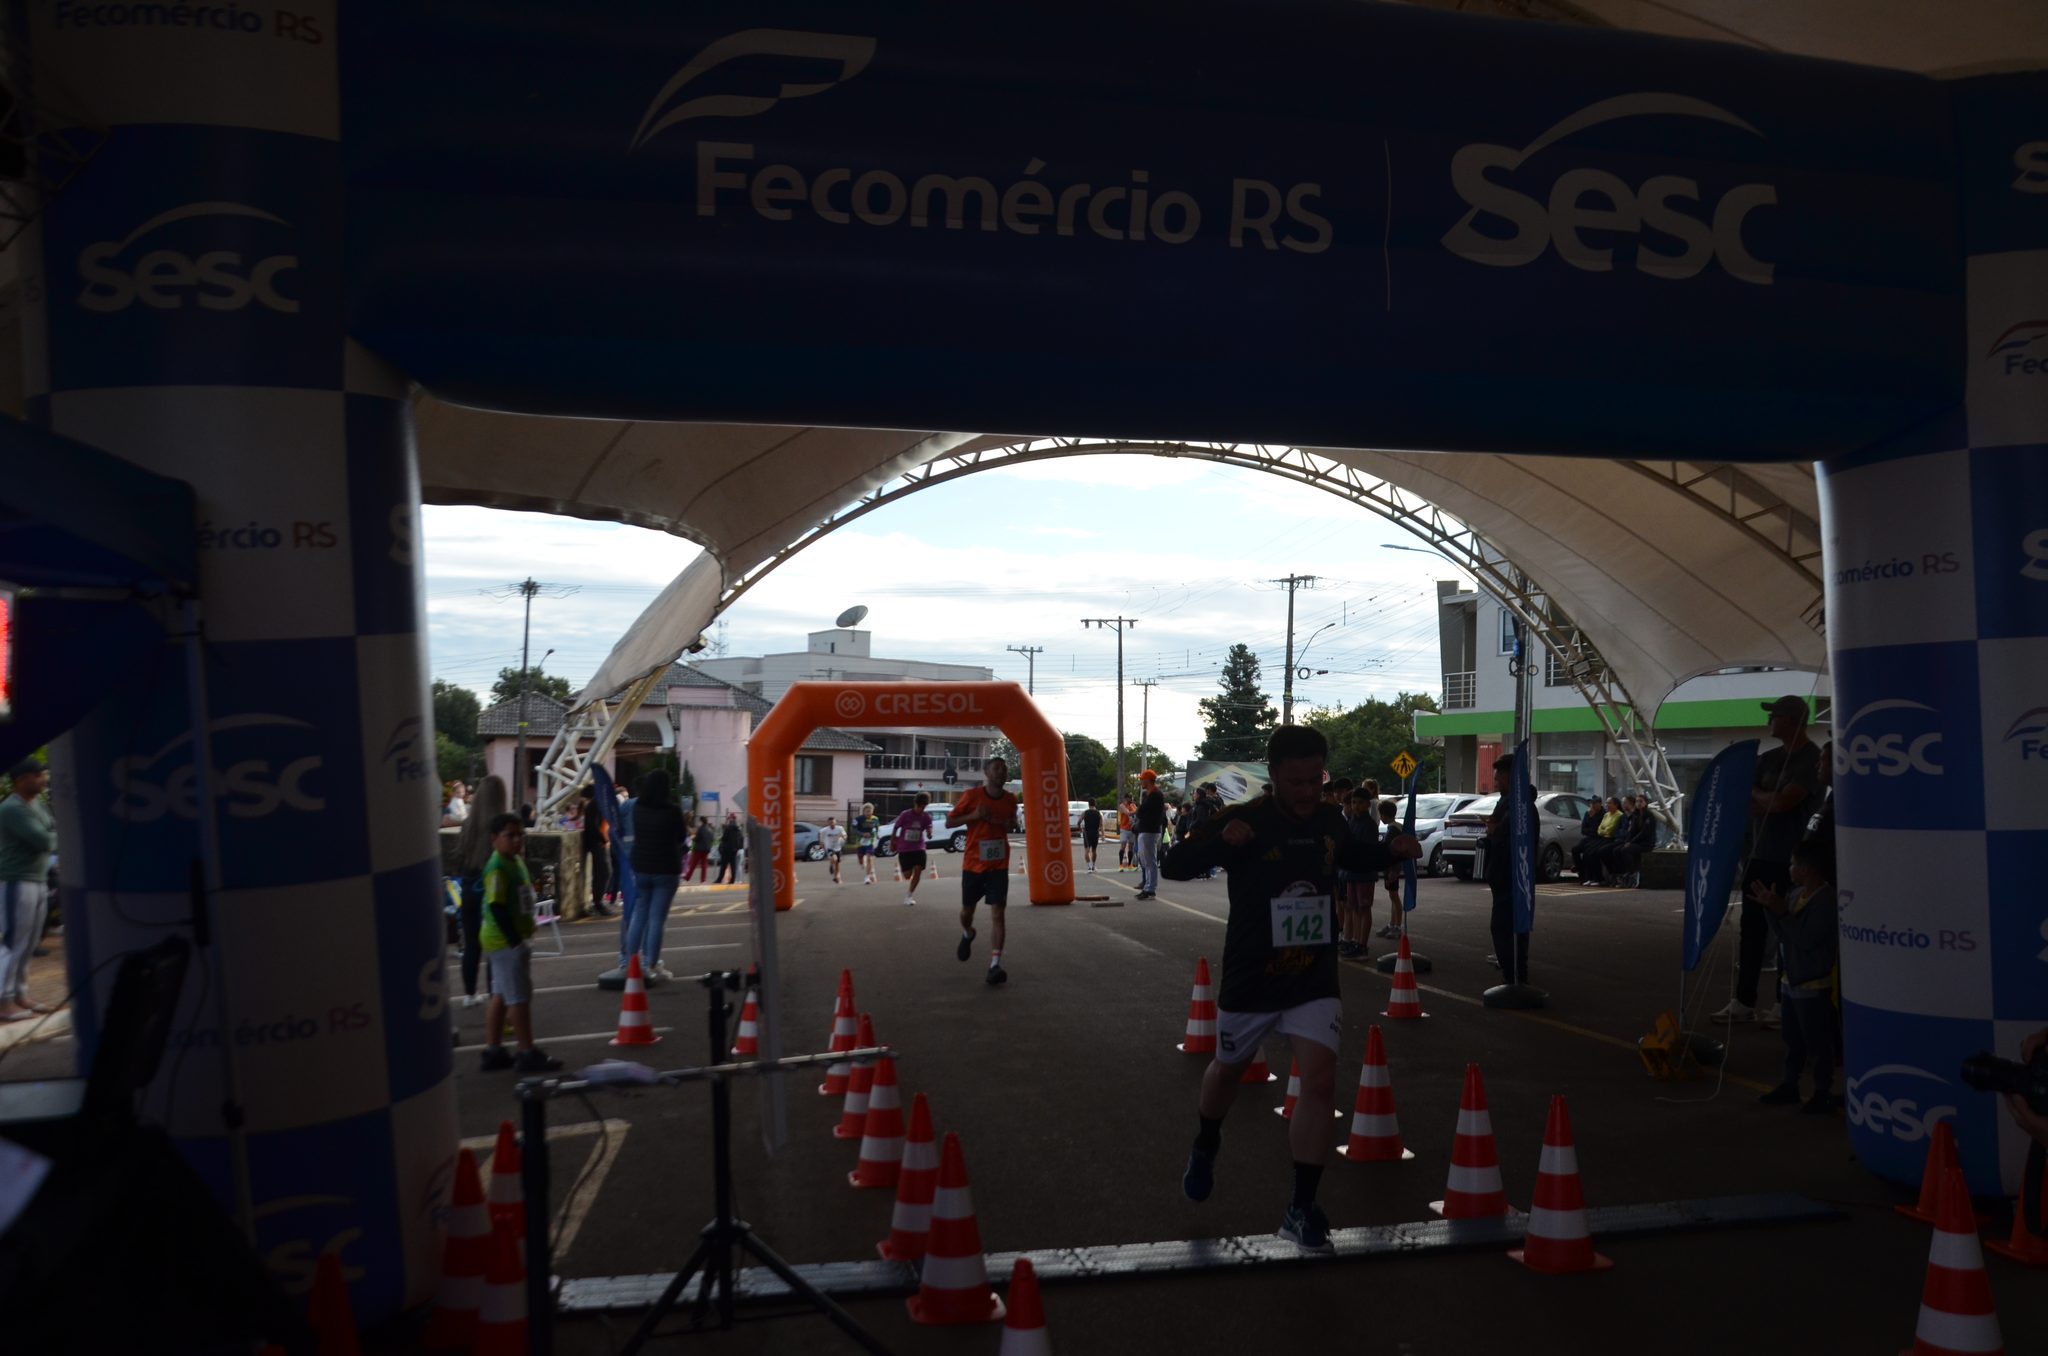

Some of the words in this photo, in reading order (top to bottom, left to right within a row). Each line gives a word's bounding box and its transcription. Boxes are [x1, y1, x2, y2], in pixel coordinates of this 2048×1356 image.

[274, 9, 323, 45] RS
[696, 140, 1201, 245] Fecomércio
[1228, 178, 1334, 255] RS
[1440, 142, 1778, 285] Sesc
[76, 240, 300, 314] Sesc
[195, 520, 282, 549] ércio
[293, 520, 337, 549] RS
[1921, 552, 1960, 575] RS
[874, 692, 983, 715] CRESOL
[1042, 762, 1063, 853] CRESOL
[1282, 914, 1324, 942] 142
[1937, 929, 1977, 951] RS
[328, 1002, 370, 1034] RS
